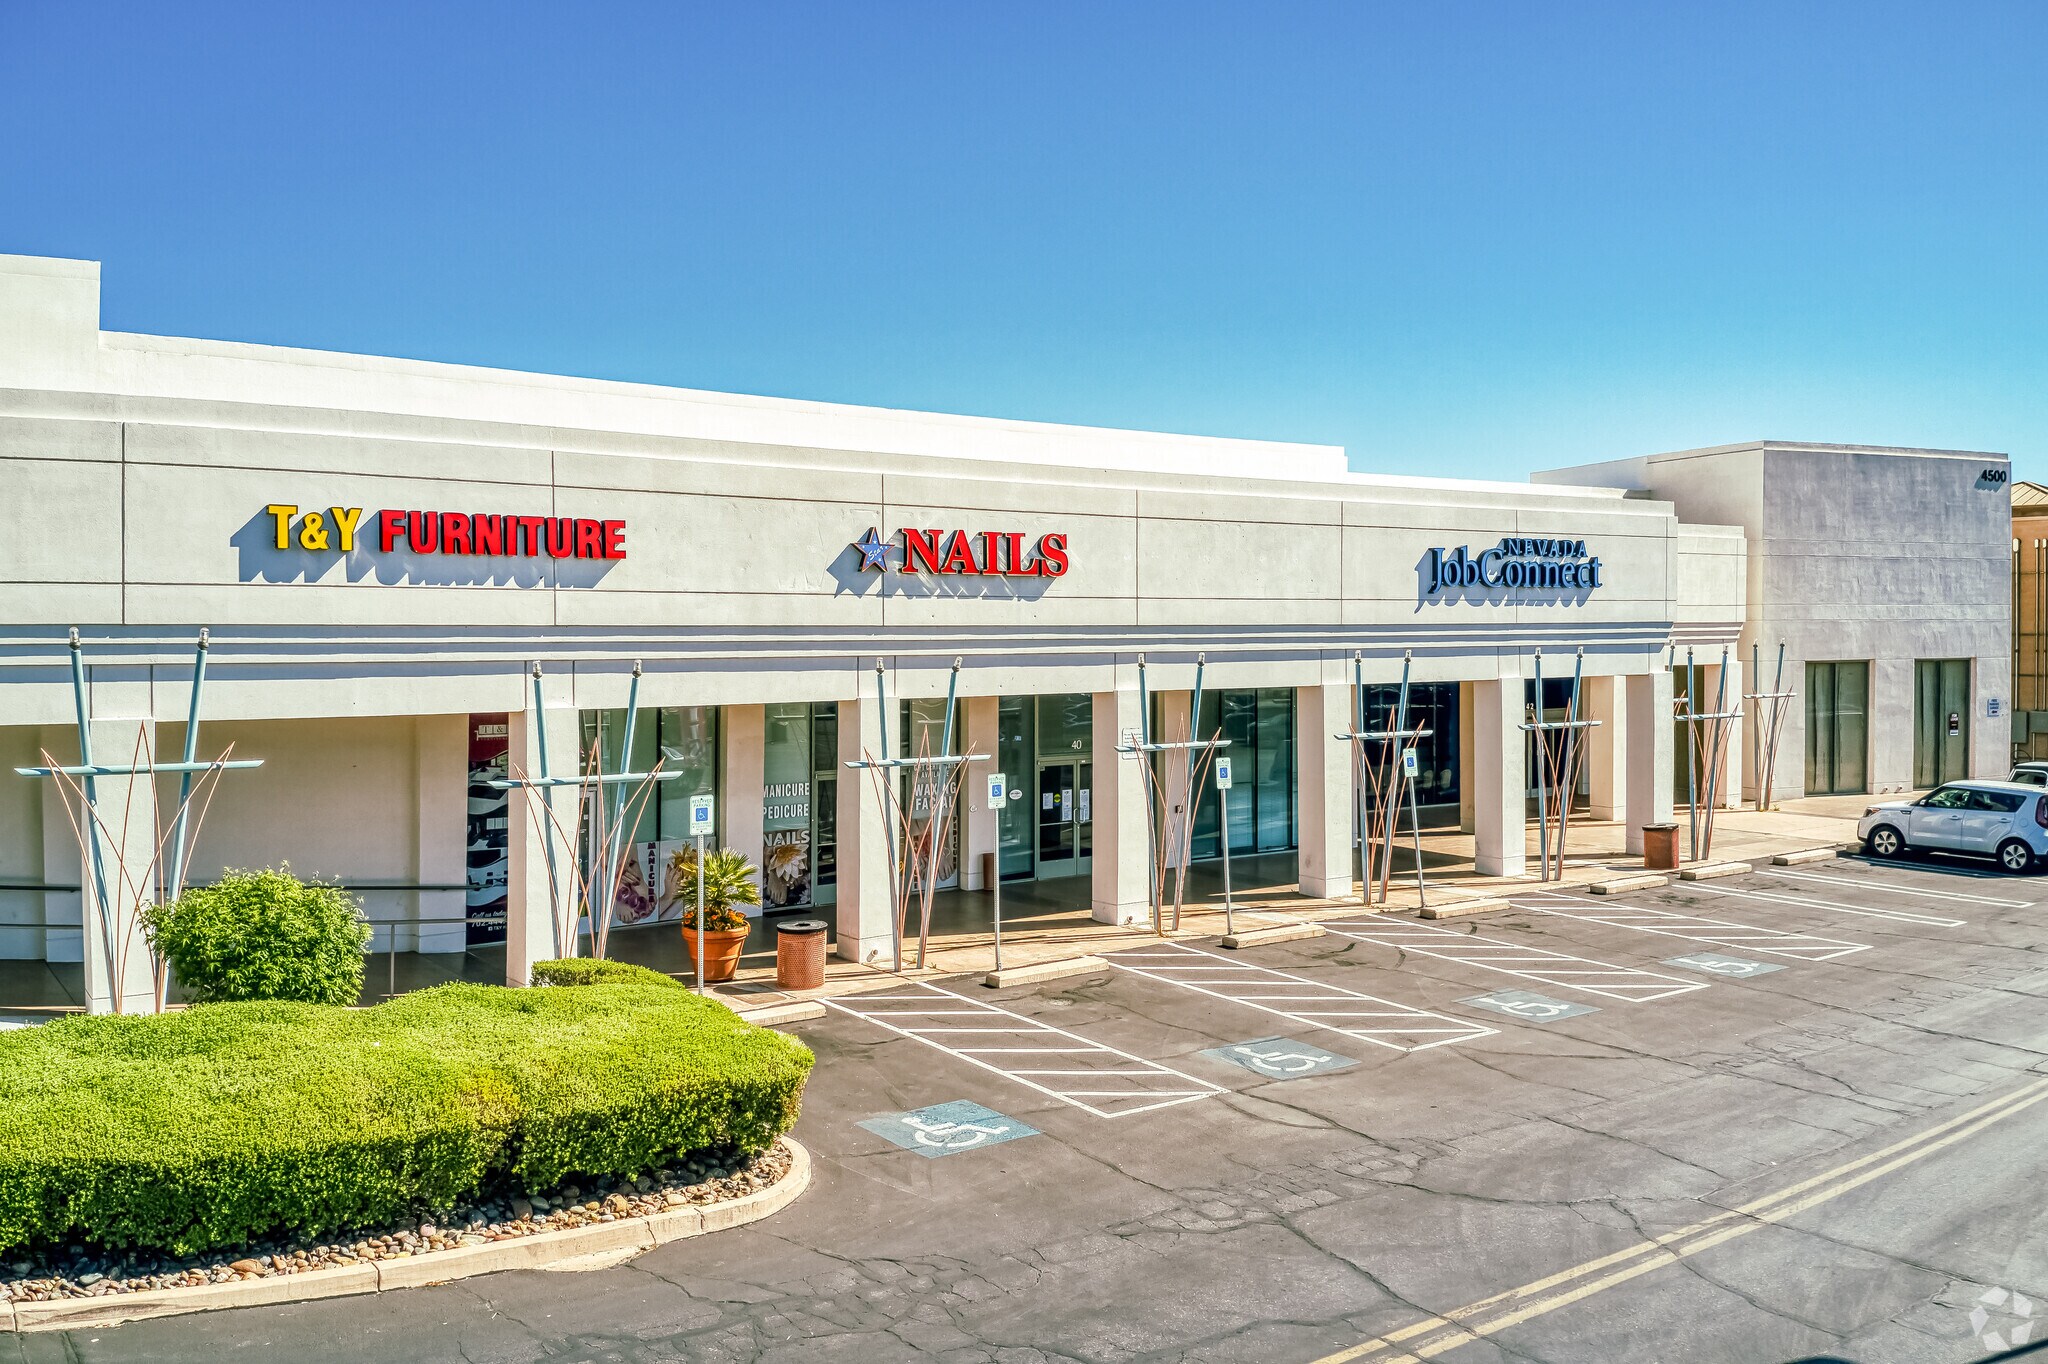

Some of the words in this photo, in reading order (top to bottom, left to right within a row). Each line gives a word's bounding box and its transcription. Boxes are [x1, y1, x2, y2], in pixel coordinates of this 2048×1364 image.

[1980, 470, 2007, 482] 4500
[266, 504, 363, 551] T&Y
[379, 509, 627, 560] FURNITURE
[1504, 538, 1588, 558] NEVADA
[899, 528, 1069, 577] NAILS
[1427, 545, 1603, 594] JobConnect
[1525, 702, 1534, 710] 42
[1071, 739, 1082, 750] 40
[647, 842, 656, 902] MANICURE
